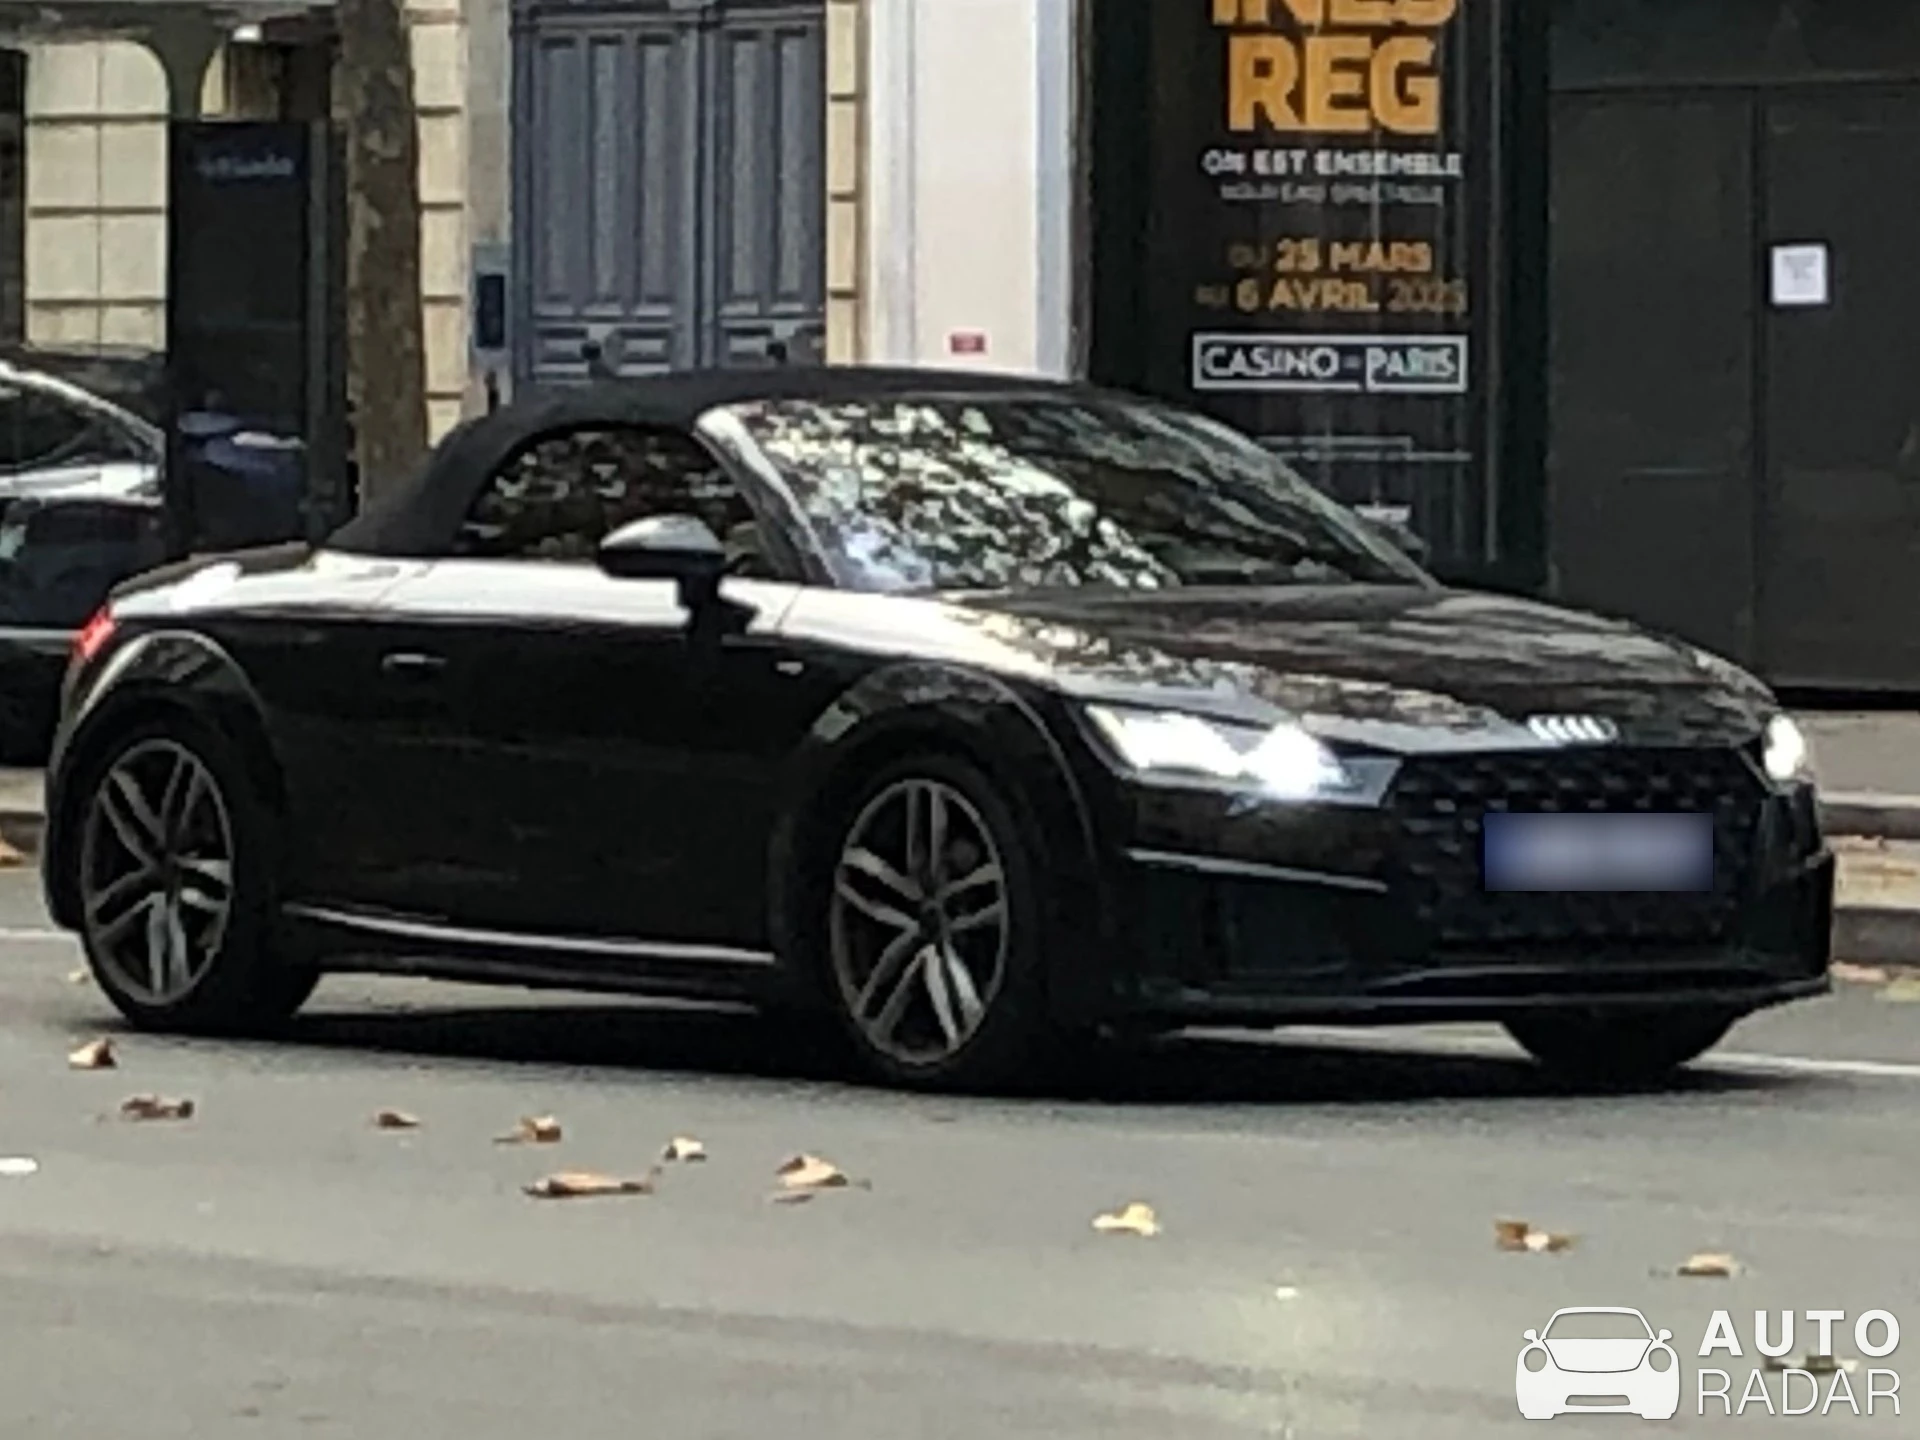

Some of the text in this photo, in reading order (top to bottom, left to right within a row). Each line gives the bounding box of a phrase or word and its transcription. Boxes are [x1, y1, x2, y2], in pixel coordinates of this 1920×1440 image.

[1229, 35, 1439, 134] REG
[1202, 149, 1462, 177] ON EST ENSEMBLE
[1329, 242, 1432, 272] MARS
[1237, 278, 1260, 311] 6
[1268, 279, 1380, 312] AVRIL
[1204, 347, 1340, 377] CASINO
[1366, 347, 1456, 378] PARIS
